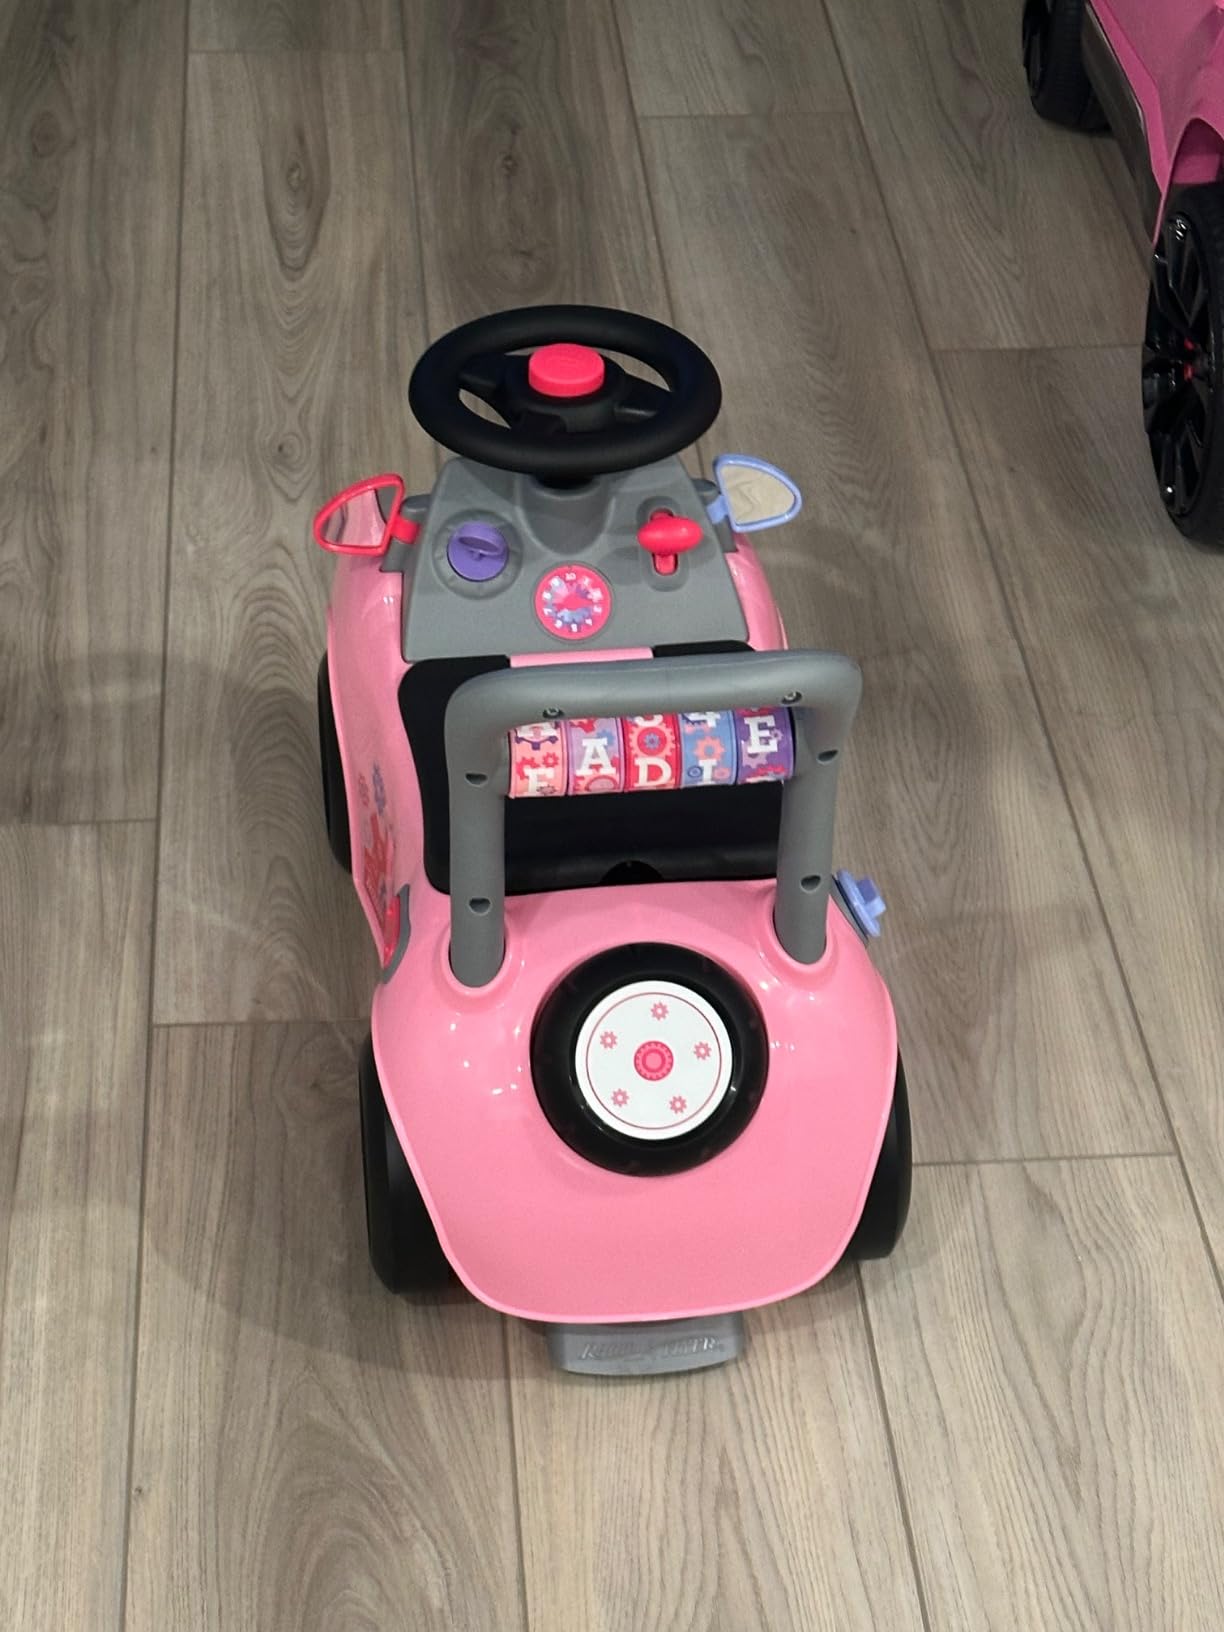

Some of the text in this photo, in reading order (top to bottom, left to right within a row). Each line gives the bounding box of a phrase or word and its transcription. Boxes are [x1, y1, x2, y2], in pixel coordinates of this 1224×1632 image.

[575, 737, 617, 775] A
[634, 757, 672, 787] D
[697, 759, 718, 786] I
[744, 715, 779, 754] E
